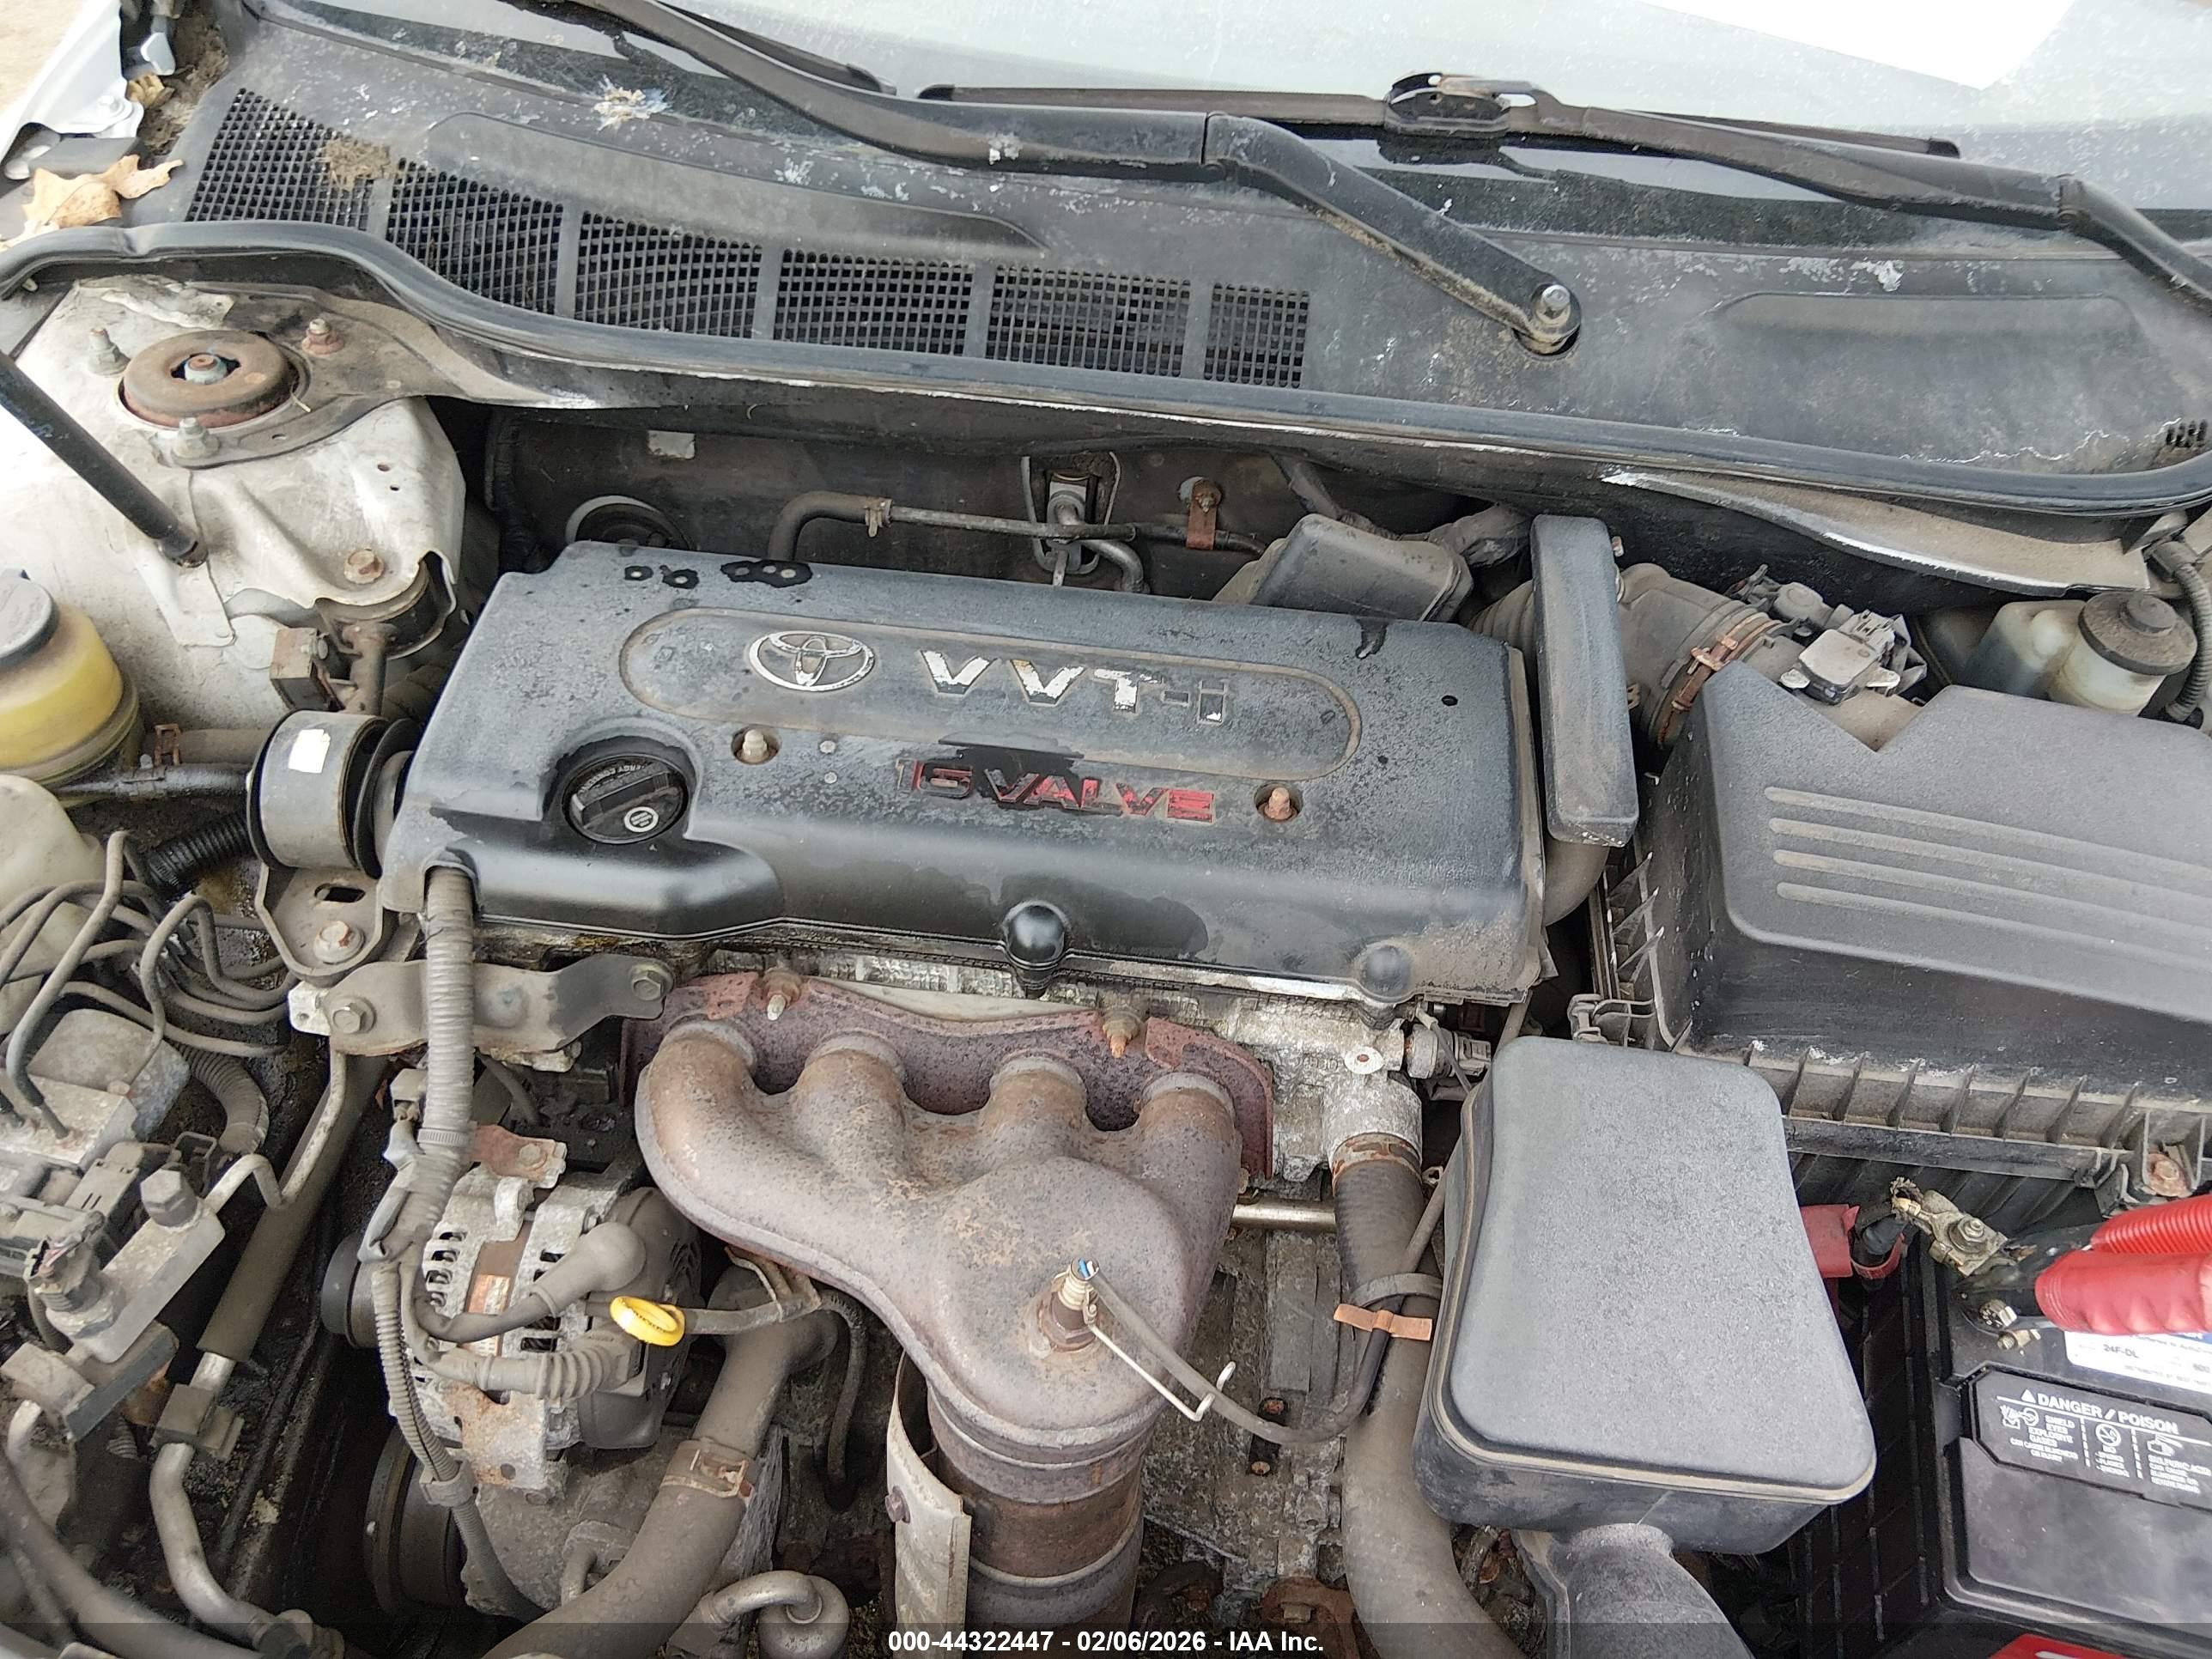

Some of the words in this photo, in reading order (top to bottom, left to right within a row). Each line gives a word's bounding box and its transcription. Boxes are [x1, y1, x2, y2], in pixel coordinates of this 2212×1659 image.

[984, 767, 1216, 824] VALVE
[2037, 1393, 2103, 1419] DANGER
[2118, 1410, 2179, 1435] POISON
